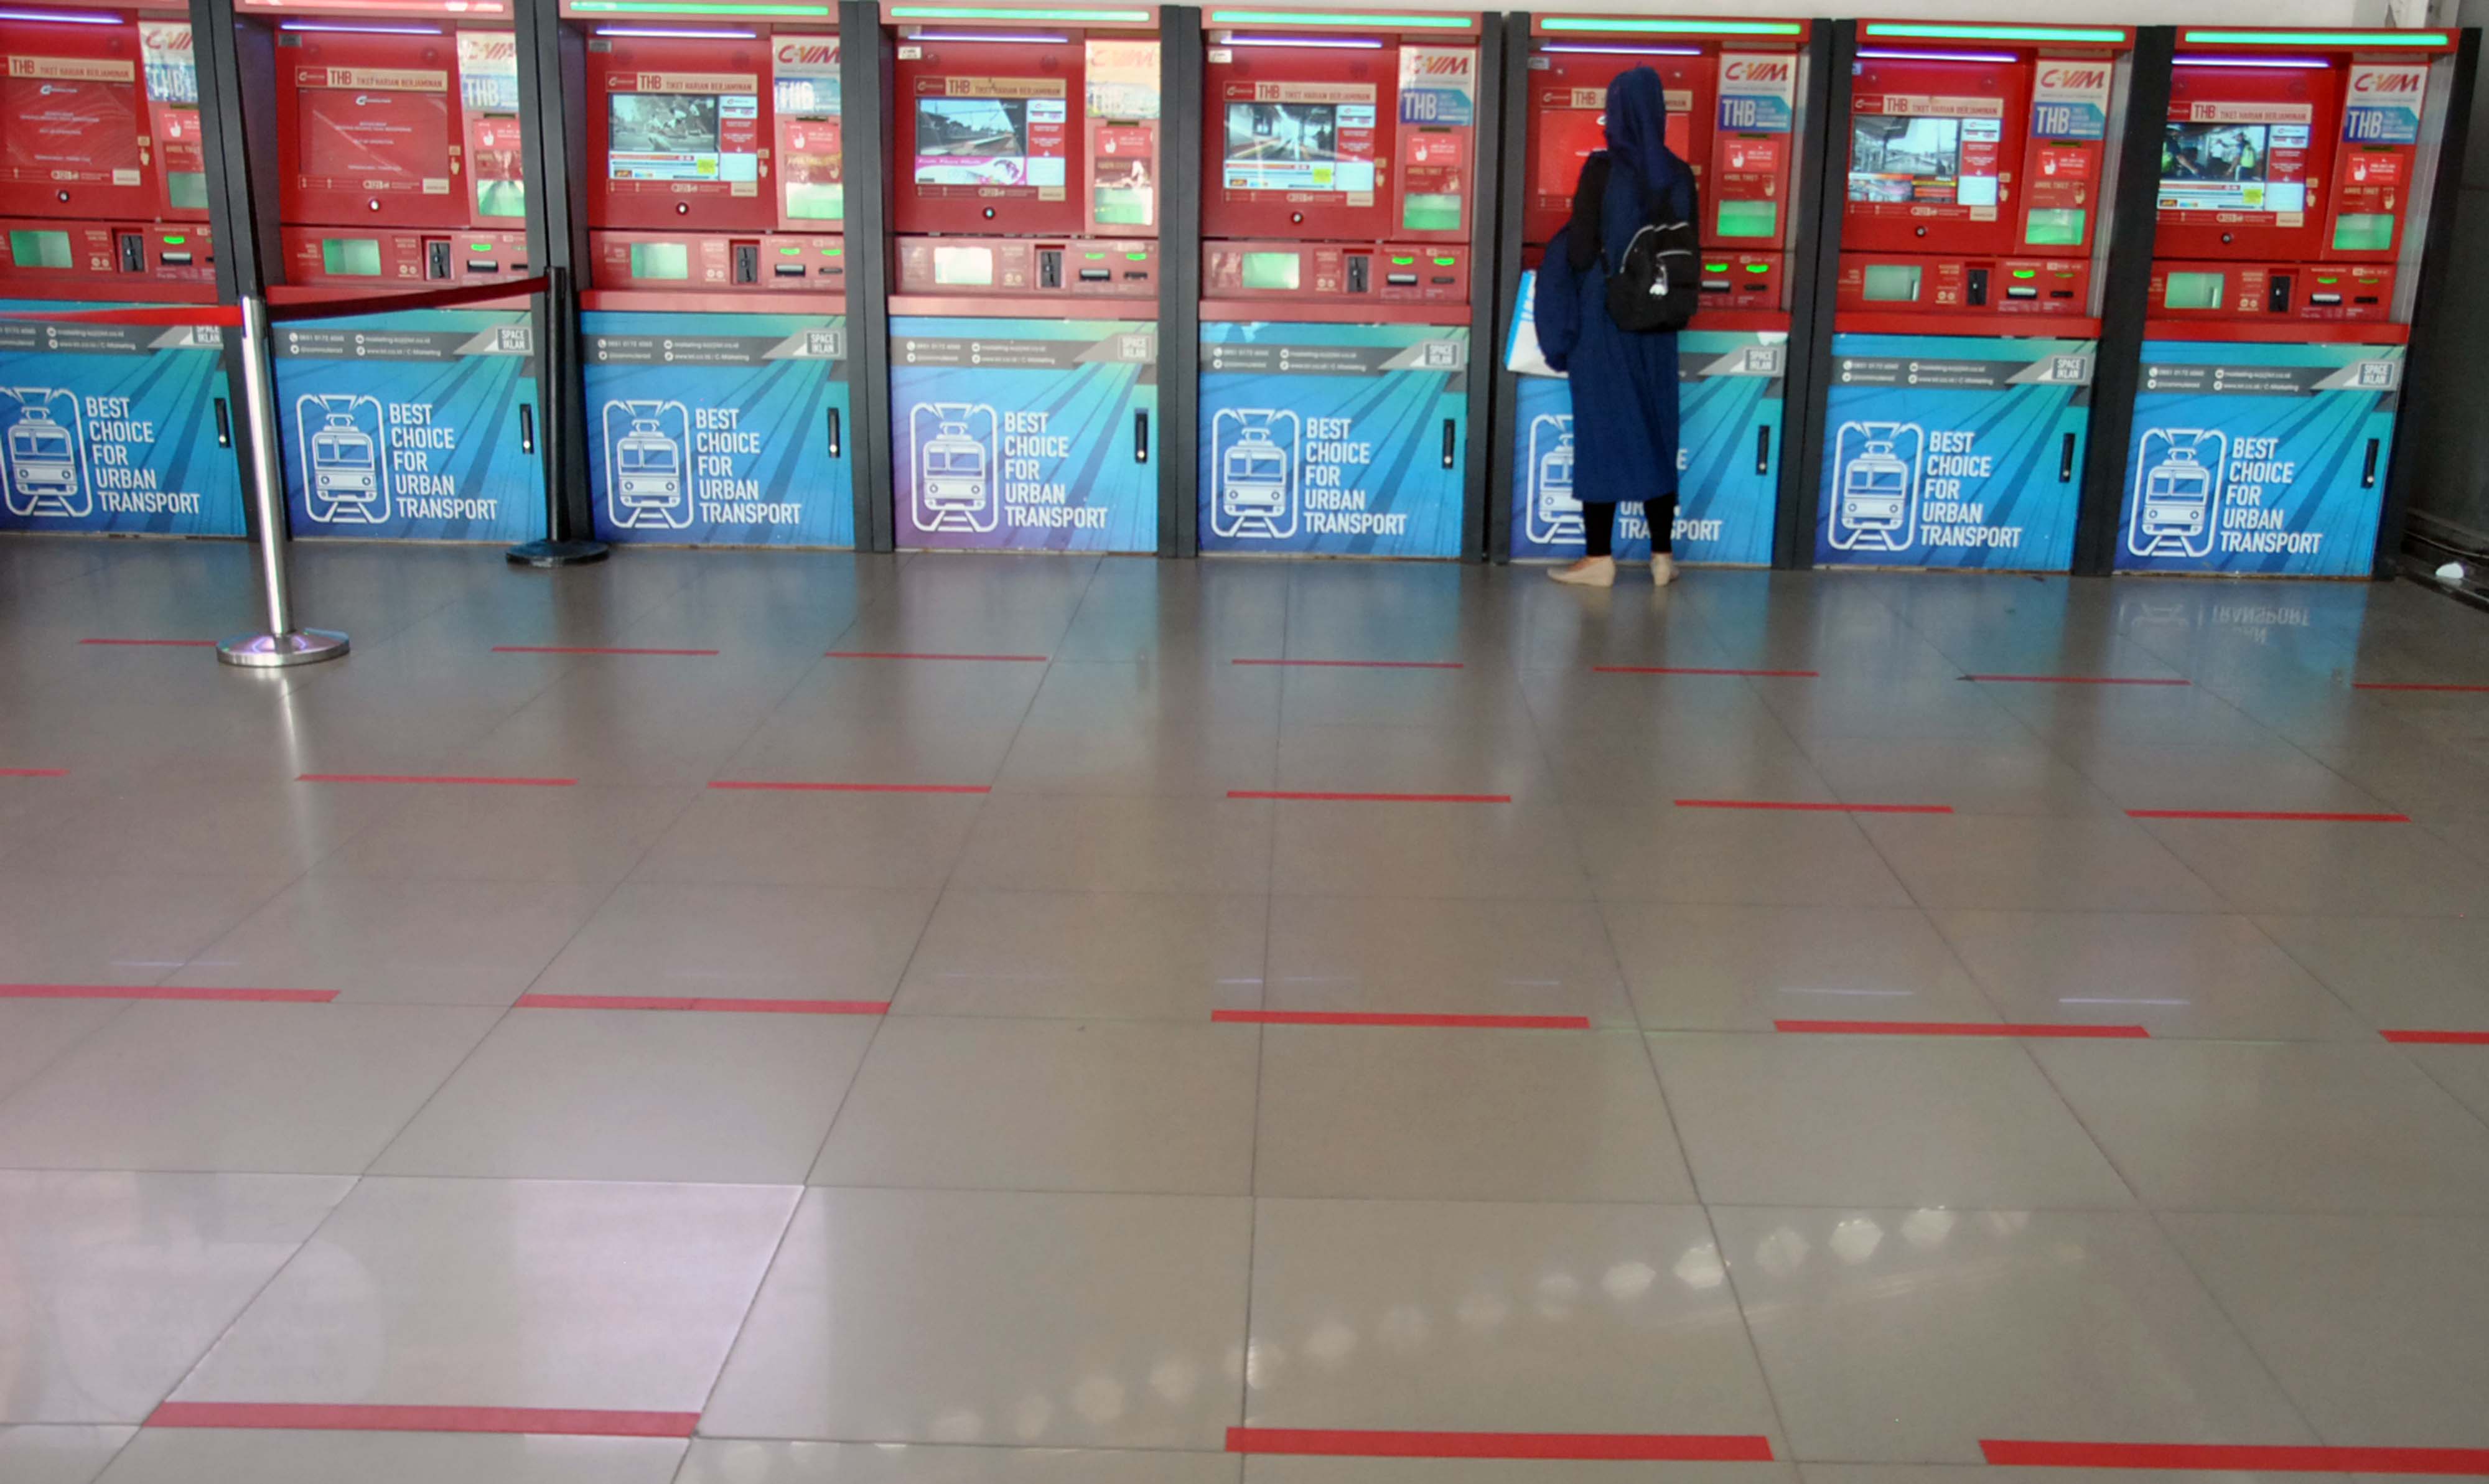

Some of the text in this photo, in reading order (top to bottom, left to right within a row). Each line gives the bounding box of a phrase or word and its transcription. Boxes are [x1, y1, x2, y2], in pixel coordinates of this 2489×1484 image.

[13, 59, 35, 75] THB
[330, 70, 352, 85] THB
[465, 78, 500, 107] THB
[640, 75, 661, 90] THB
[948, 80, 970, 95] THB
[1258, 85, 1280, 99] THB
[1403, 93, 1437, 120] THB
[1574, 91, 1597, 105] THB
[1887, 97, 1908, 112] THB
[1722, 99, 1755, 127] THB
[2036, 105, 2070, 134] THB
[2193, 104, 2216, 119] THB
[2348, 111, 2383, 138] THB
[502, 330, 525, 340] SPACE
[810, 334, 834, 343] SPACE
[1122, 337, 1146, 347] SPACE
[812, 343, 834, 353] IKLAN
[1429, 344, 1453, 355] SPACE
[1750, 350, 1773, 360] SPACE
[2057, 359, 2081, 370] SPACE
[2364, 363, 2389, 374] SPACE
[2363, 373, 2387, 385] IKLAN
[85, 397, 130, 418] BEST
[389, 403, 432, 425] BEST
[695, 408, 739, 429] BEST
[89, 421, 154, 443] CHOICE
[1004, 411, 1048, 434] BEST
[1306, 418, 1352, 439] BEST
[391, 428, 455, 449] CHOICE
[696, 432, 760, 454] CHOICE
[1004, 436, 1069, 458] CHOICE
[1930, 431, 1974, 453] BEST
[2233, 437, 2278, 460] BEST
[92, 444, 128, 466] FOR
[393, 450, 427, 472] FOR
[1305, 442, 1370, 464] CHOICE
[698, 455, 732, 477] FOR
[1005, 459, 1040, 480] FOR
[1305, 465, 1340, 487] FOR
[1926, 455, 1991, 477] CHOICE
[2229, 461, 2295, 484] CHOICE
[95, 469, 157, 490] URBAN
[395, 475, 455, 496] URBAN
[699, 480, 759, 501] URBAN
[1925, 478, 1960, 500] FOR
[98, 491, 200, 514] TRANSPORT
[1005, 483, 1066, 505] URBAN
[1305, 489, 1365, 511] URBAN
[2226, 485, 2262, 506] FOR
[396, 498, 497, 520] TRANSPORT
[700, 503, 801, 525] TRANSPORT
[1005, 506, 1108, 528] TRANSPORT
[1922, 503, 1983, 523] URBAN
[2223, 509, 2284, 530] URBAN
[1304, 512, 1407, 534] TRANSPORT
[1619, 518, 1722, 541] TRAPORT
[1920, 525, 2022, 548] TRANSPORT
[2220, 531, 2323, 554] TRANSPORT
